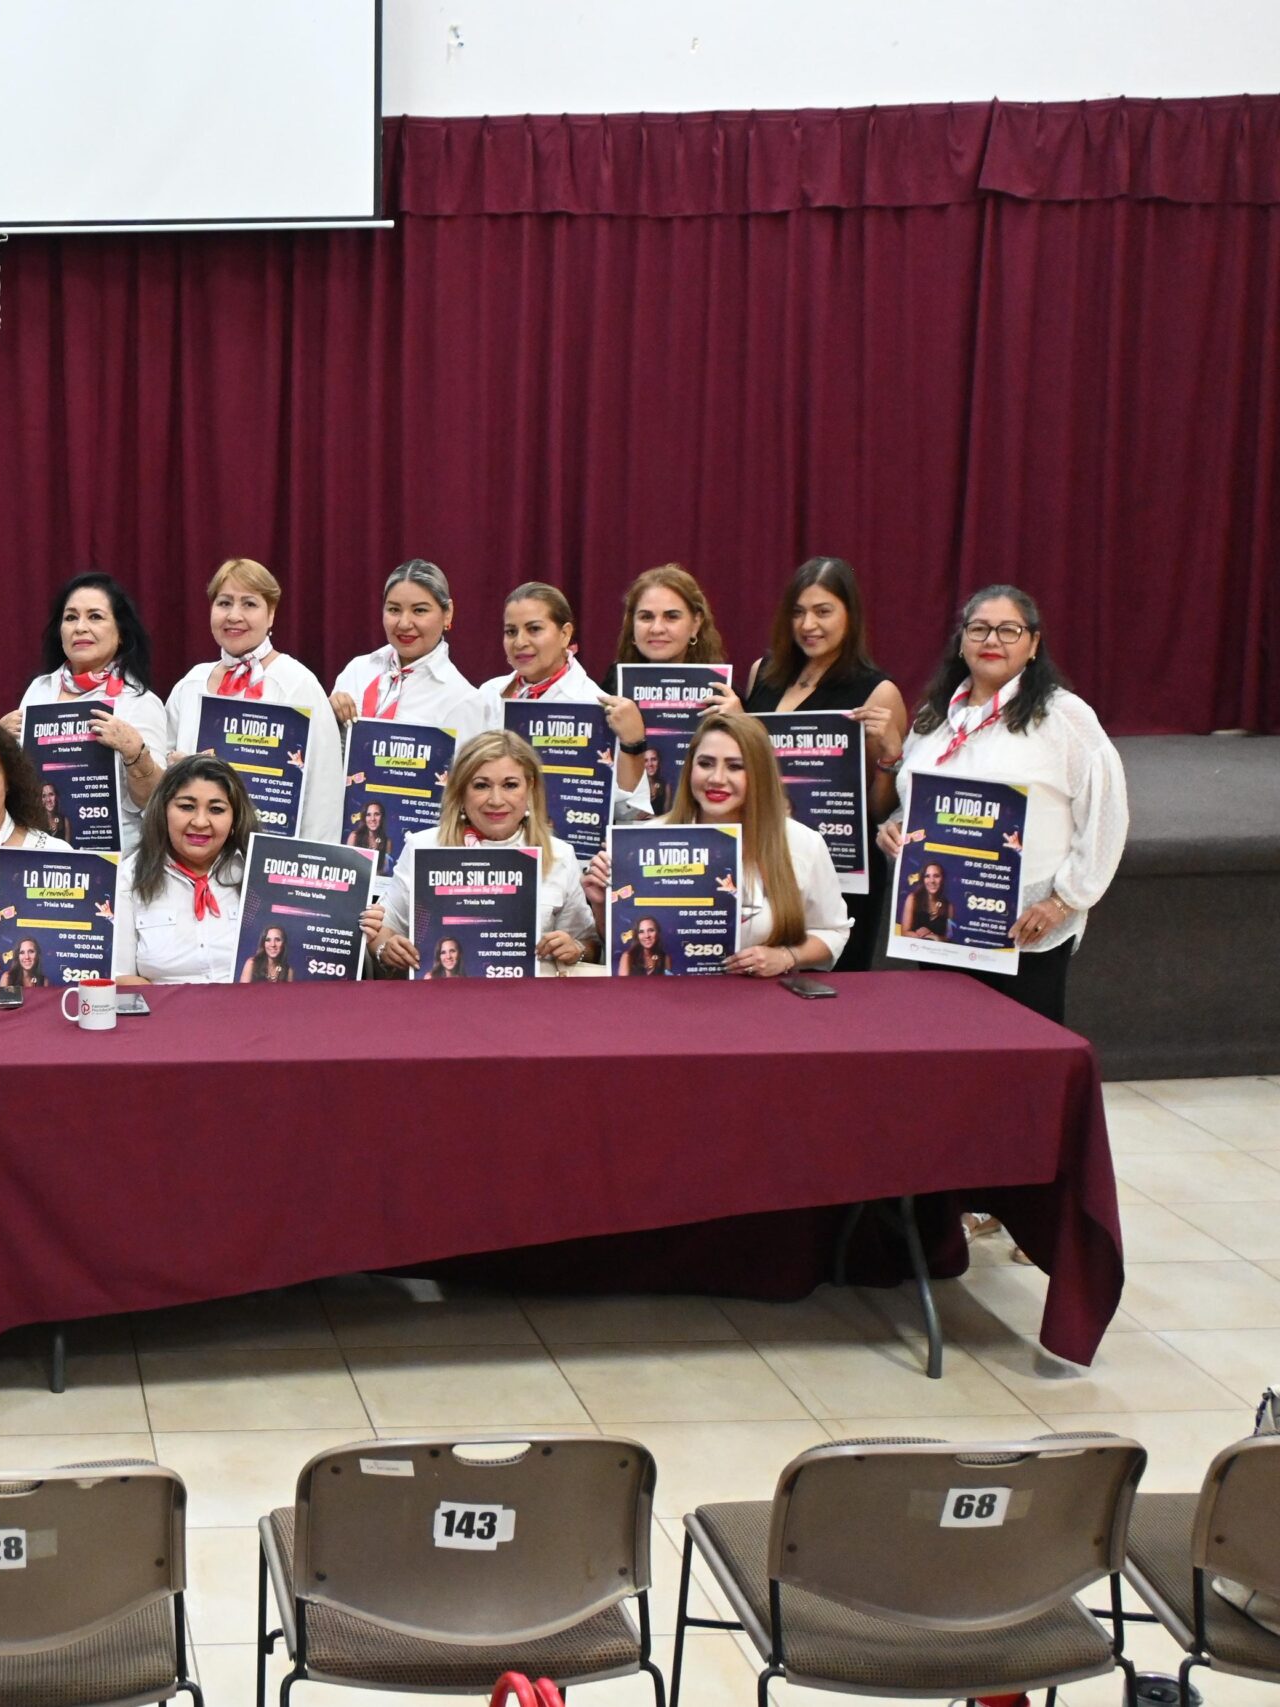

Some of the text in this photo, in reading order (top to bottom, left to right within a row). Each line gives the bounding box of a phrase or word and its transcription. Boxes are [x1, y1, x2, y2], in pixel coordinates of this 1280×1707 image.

[634, 687, 662, 700] EDUCA
[665, 687, 680, 701] SIN
[34, 724, 58, 737] EDUCA
[61, 722, 74, 735] SIN
[224, 717, 284, 739] LA VIDA EN
[529, 721, 592, 738] LA VIDA EN
[798, 735, 813, 748] SIN
[816, 734, 848, 748] CULPA
[373, 740, 431, 761] LA VIDA EN
[79, 806, 109, 819] $250
[936, 795, 1000, 820] LA VIDA EN
[566, 810, 599, 824] $250
[819, 823, 852, 836] $250
[639, 848, 709, 866] LA VIDA EN
[24, 870, 90, 890] LA VIDA EN
[264, 859, 298, 875] EDUCA
[301, 863, 319, 879] SIN
[322, 866, 356, 885] CULPA
[429, 871, 522, 886] EDUCA SIN CULPA
[967, 895, 1006, 913] $250
[326, 927, 353, 936] OCTUBRE
[685, 944, 723, 957] $250
[63, 968, 100, 982] $250
[308, 959, 345, 976] $250
[486, 965, 523, 978] $250
[952, 1494, 997, 1519] 68
[441, 1510, 498, 1540] 143
